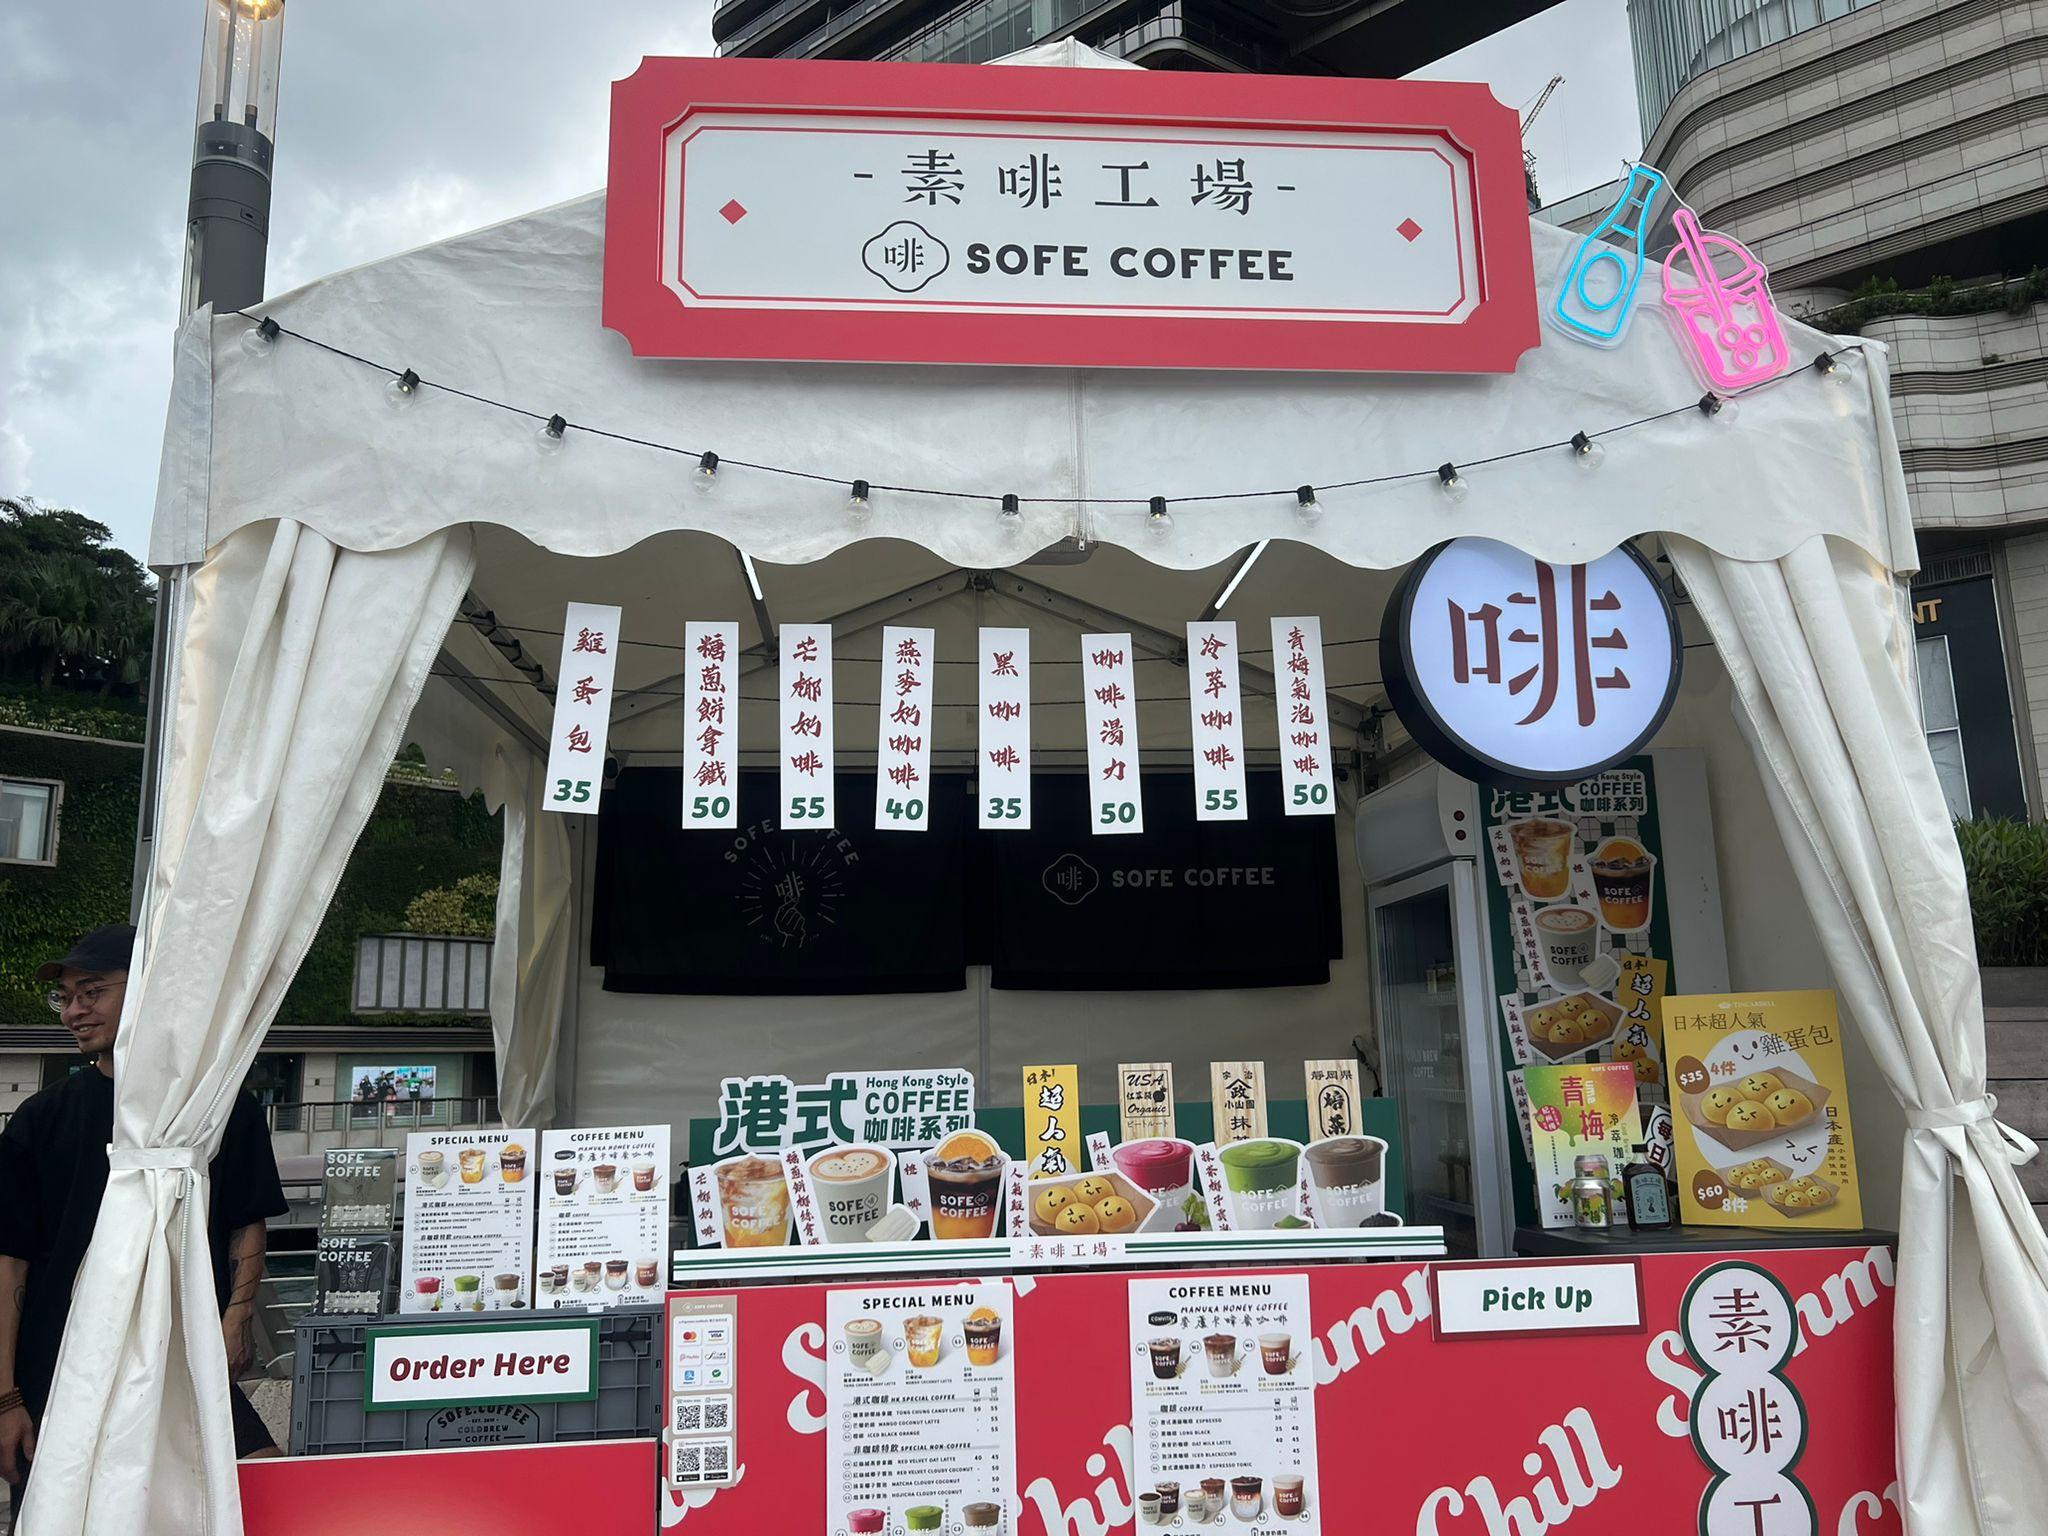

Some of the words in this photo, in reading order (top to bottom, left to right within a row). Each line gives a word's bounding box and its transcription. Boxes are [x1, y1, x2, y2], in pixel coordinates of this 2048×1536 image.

[884, 238, 924, 275] 啡
[966, 243, 1089, 277] SOFE
[1110, 247, 1294, 281] COFFEE
[1448, 559, 1631, 727] 啡
[791, 636, 823, 778] 芒椰奶啡
[988, 651, 1020, 772] 黑咖啡
[1199, 633, 1235, 771] 冷萃咖啡
[888, 638, 922, 789] 燕麥奶咖啡
[1092, 649, 1126, 781] 咖啡湯力
[553, 779, 591, 802] 35
[1293, 784, 1328, 805] 50
[1579, 782, 1642, 795] COFFEE
[692, 797, 729, 819] 50
[789, 797, 824, 818] 55
[886, 799, 923, 820] 40
[988, 798, 1021, 819] 35
[1204, 789, 1238, 810] 55
[1580, 797, 1643, 812] 咖啡系列
[1100, 802, 1136, 824] 50
[724, 819, 774, 863] SOFE
[1057, 866, 1082, 891] 啡
[1112, 870, 1173, 887] SOFE
[1184, 867, 1274, 886] COFFEE
[1550, 946, 1577, 955] SOFE
[1552, 956, 1589, 965] COFFEE
[1674, 1012, 1766, 1031] 日本超人氣
[1760, 1024, 1833, 1057] 雞蛋包
[1680, 1070, 1703, 1086] $35
[1710, 1061, 1736, 1076] 4件
[866, 1077, 898, 1090] Hong
[902, 1076, 933, 1088] Kong
[937, 1074, 968, 1087] Style
[1127, 1074, 1164, 1086] USA
[865, 1089, 968, 1114] COFFEE
[1128, 1103, 1167, 1117] Organic
[1560, 1076, 1604, 1141] 青梅
[719, 1078, 858, 1148] 港式
[571, 1133, 610, 1141] COFFEE
[615, 1131, 644, 1140] MENU
[864, 1114, 970, 1142] 咖啡系列
[431, 1136, 474, 1145] SPECIAL
[479, 1135, 509, 1143] MENU
[327, 1153, 365, 1163] SOFE
[1092, 1139, 1110, 1170] 紅絲
[326, 1167, 381, 1177] COFFEE
[940, 1195, 974, 1206] SOFE
[1698, 1185, 1722, 1200] $60
[829, 1199, 863, 1212] SOFE
[940, 1206, 987, 1218] COFFEE
[1722, 1197, 1748, 1213] 8件
[830, 1208, 878, 1225] COFFEE
[321, 1238, 357, 1249] SOFE
[1030, 1242, 1107, 1259] 素啡工場
[319, 1252, 372, 1262] COFFEE
[1169, 1287, 1224, 1298] COFFEE
[1230, 1285, 1271, 1296] MENU
[1482, 1286, 1545, 1312] Pick
[1556, 1286, 1592, 1313] Up
[863, 1297, 925, 1310] SPECIAL
[932, 1294, 974, 1307] MENU
[1181, 1305, 1219, 1313] MANUKA
[1223, 1304, 1252, 1312] HONEY
[1256, 1302, 1288, 1311] COFFEE
[389, 1355, 485, 1382] Order
[493, 1352, 571, 1377] Here
